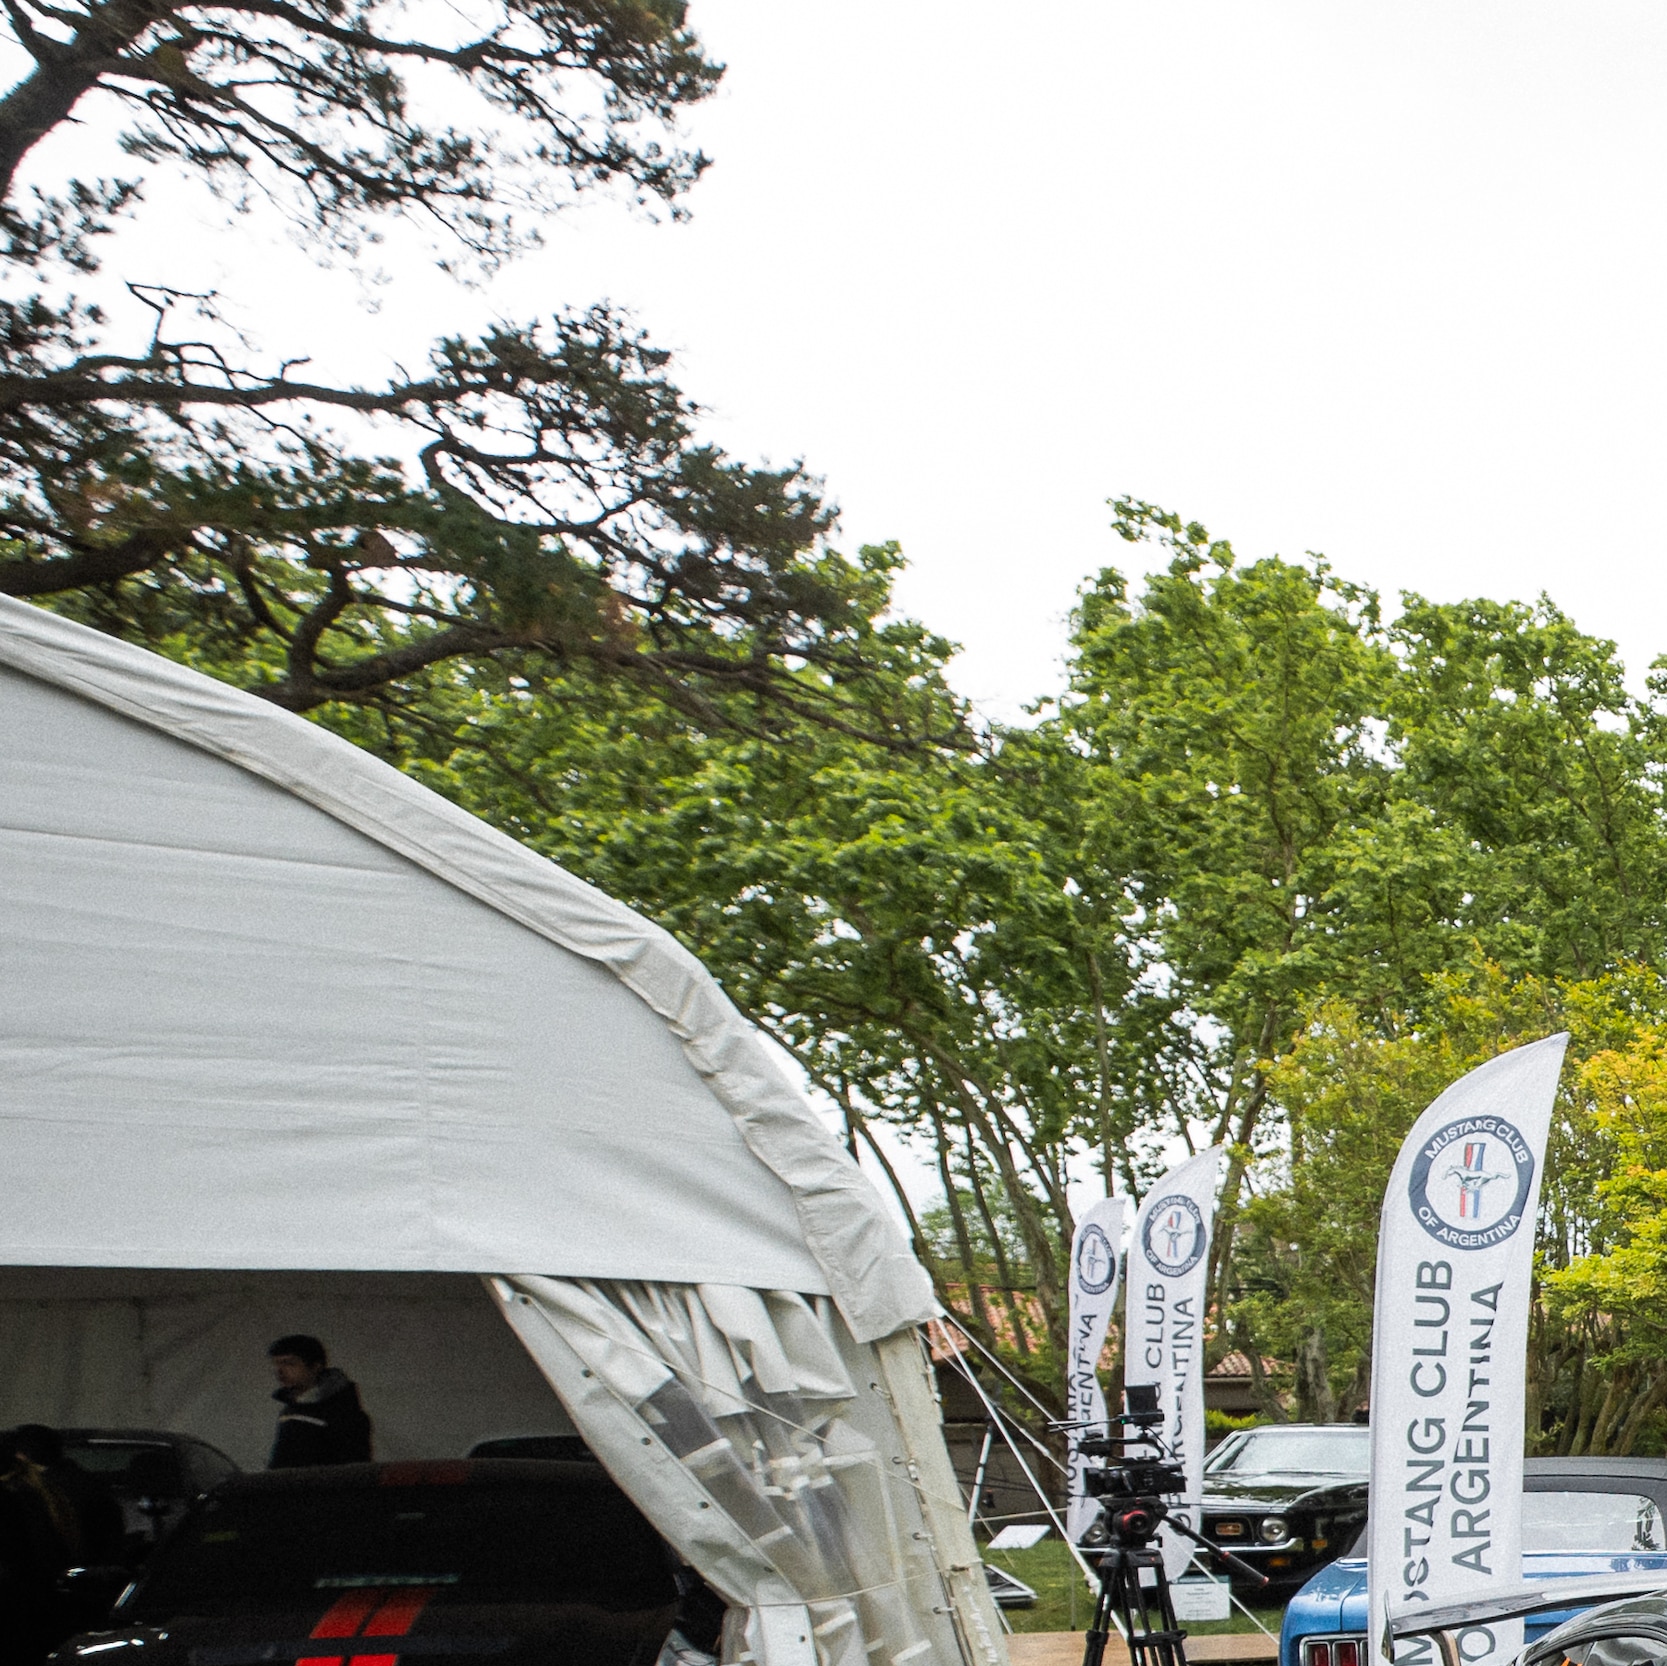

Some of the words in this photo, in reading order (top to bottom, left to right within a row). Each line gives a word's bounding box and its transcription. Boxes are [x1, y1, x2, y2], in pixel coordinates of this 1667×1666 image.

[1425, 1119, 1496, 1160] MUSTANG
[1495, 1126, 1528, 1164] CLUB
[1418, 1206, 1439, 1228] OF
[1436, 1214, 1521, 1247] ARGENTINA
[1145, 1283, 1166, 1369] CLUB
[1410, 1260, 1453, 1398] CLUB
[1451, 1281, 1504, 1576] ARGENTINA
[1457, 1624, 1497, 1663] O
